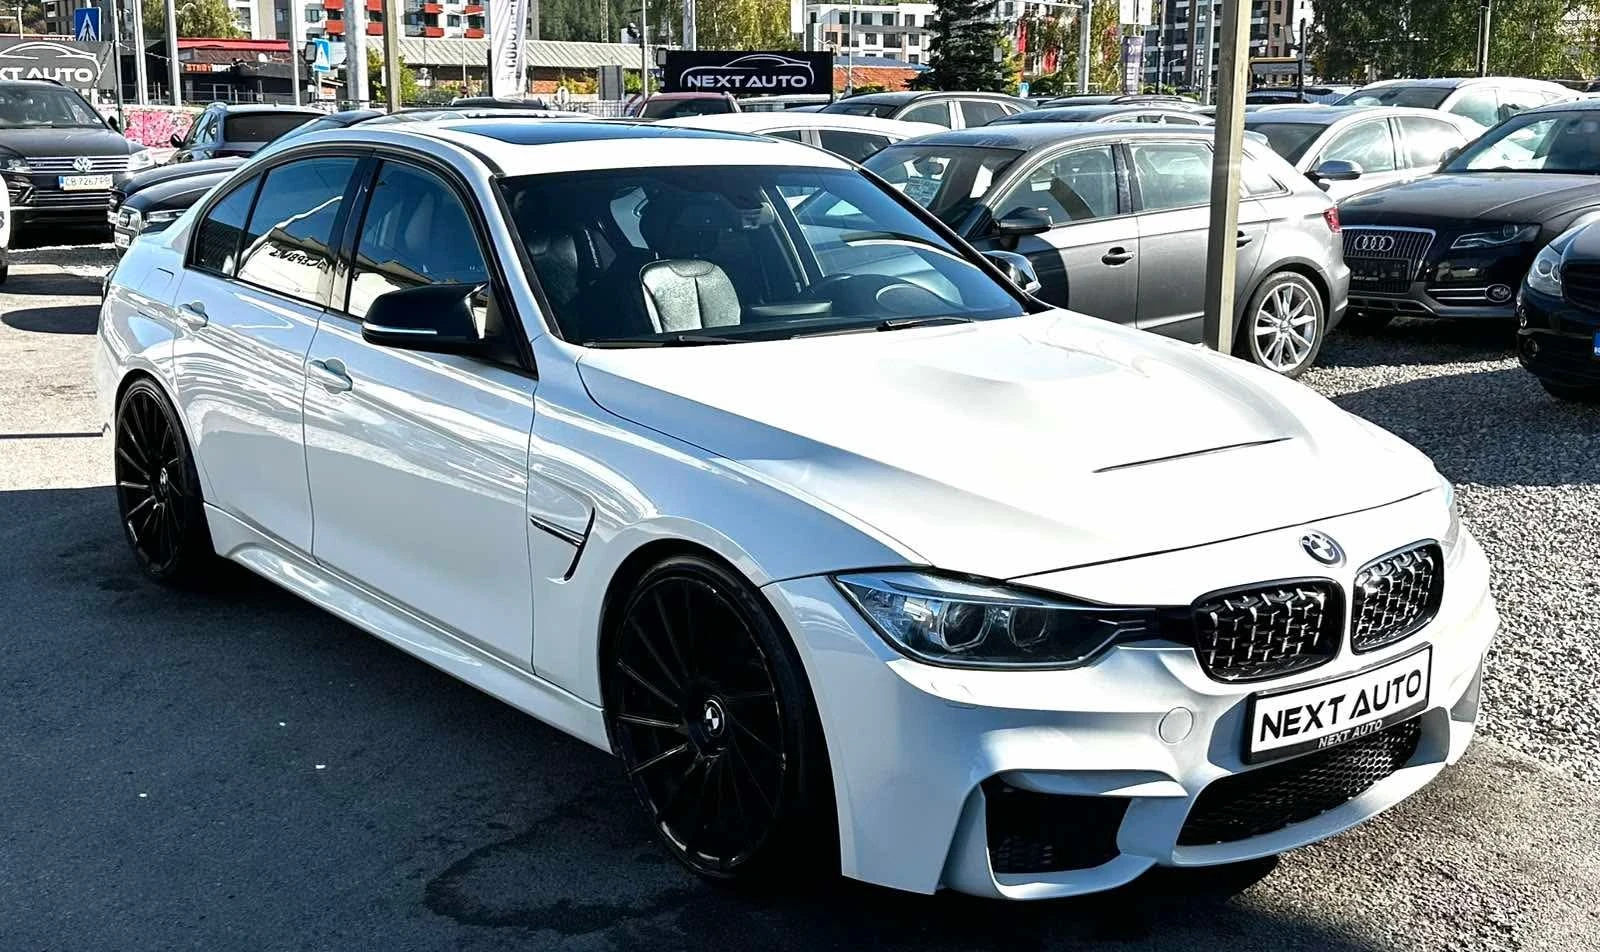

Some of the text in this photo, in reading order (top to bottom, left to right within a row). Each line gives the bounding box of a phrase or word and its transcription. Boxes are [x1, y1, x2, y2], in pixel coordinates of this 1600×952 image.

[26, 67, 93, 82] AUTO
[687, 75, 808, 88] NEXT AUTO
[1260, 669, 1421, 742] NEXT AUTO
[1318, 719, 1382, 749] NEXT AUTO
